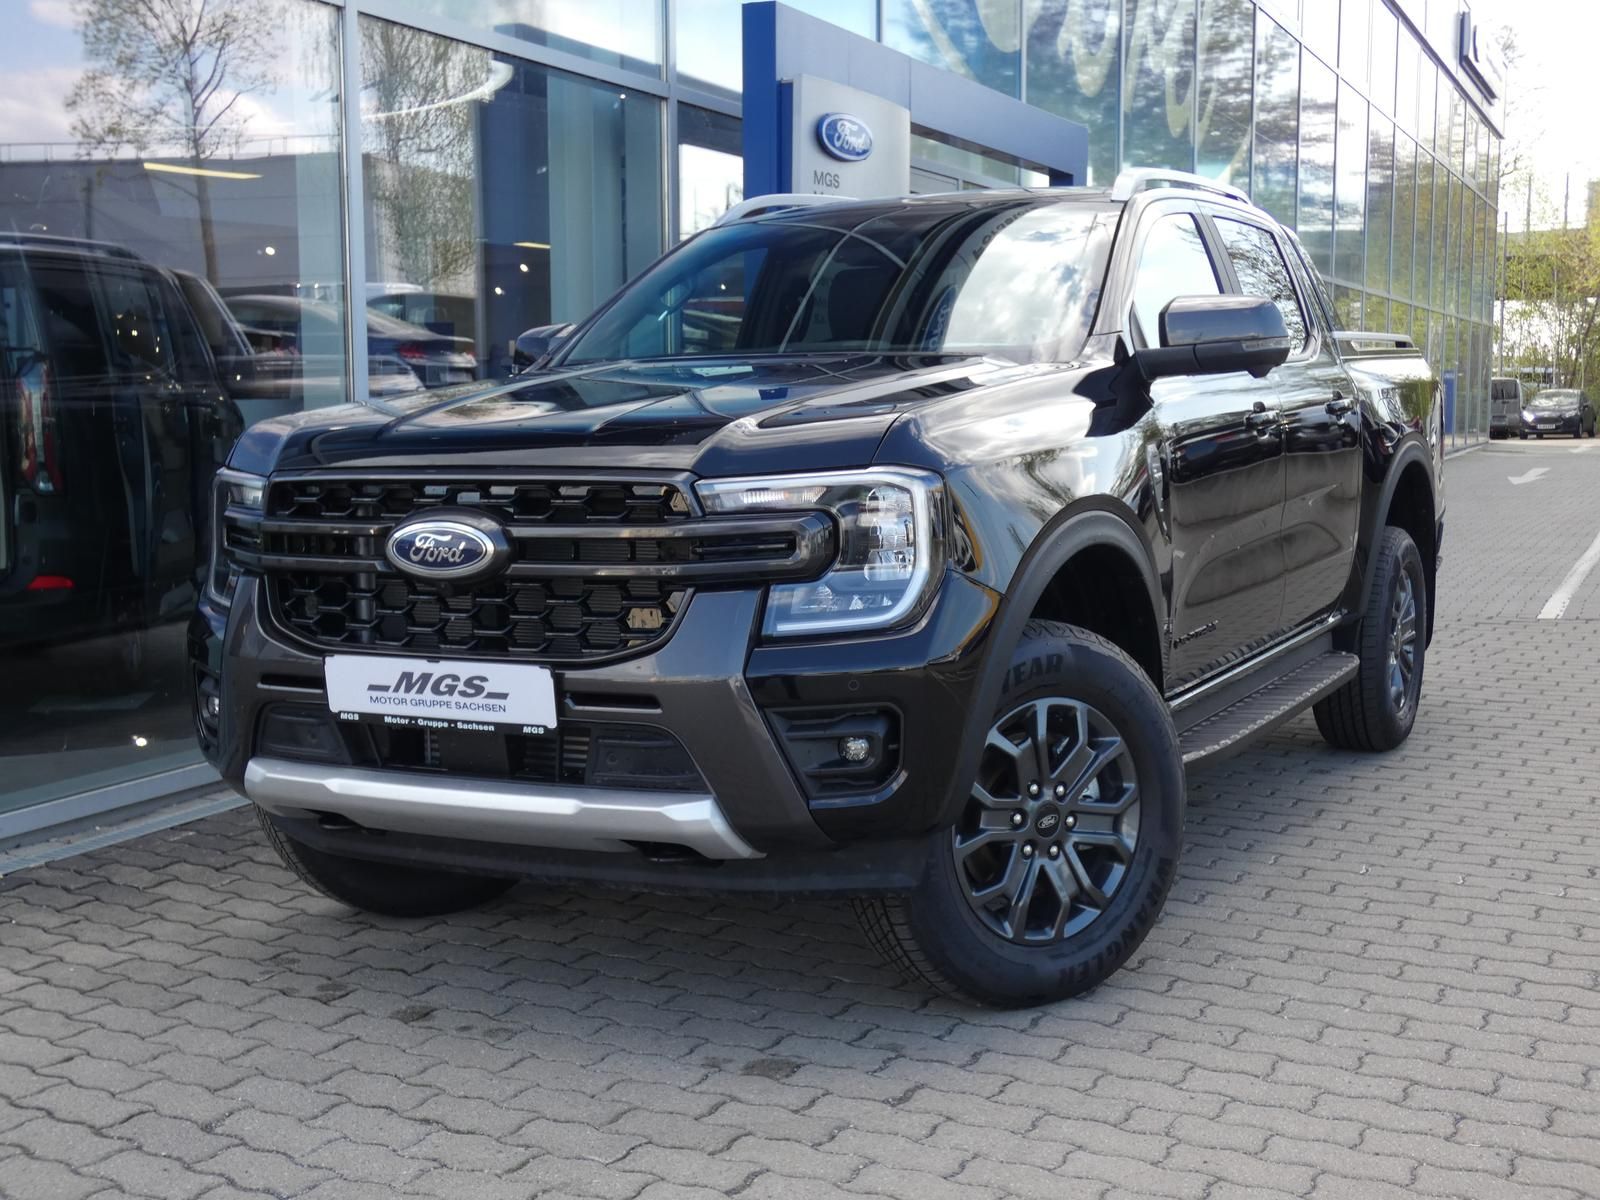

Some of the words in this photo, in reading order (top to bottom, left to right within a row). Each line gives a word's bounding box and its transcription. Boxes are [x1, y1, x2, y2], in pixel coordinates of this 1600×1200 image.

[834, 121, 867, 153] Ford
[814, 170, 840, 189] MGS
[409, 533, 466, 562] Ford
[391, 671, 489, 698] MGS
[369, 695, 408, 707] MOTOR
[410, 698, 452, 709] GRUPPE
[454, 701, 507, 713] SACHSEN
[340, 712, 360, 721] MGS
[384, 716, 409, 725] Motor
[417, 718, 448, 729] Gruppe
[457, 721, 495, 732] Sachsen
[522, 726, 545, 735] MGS
